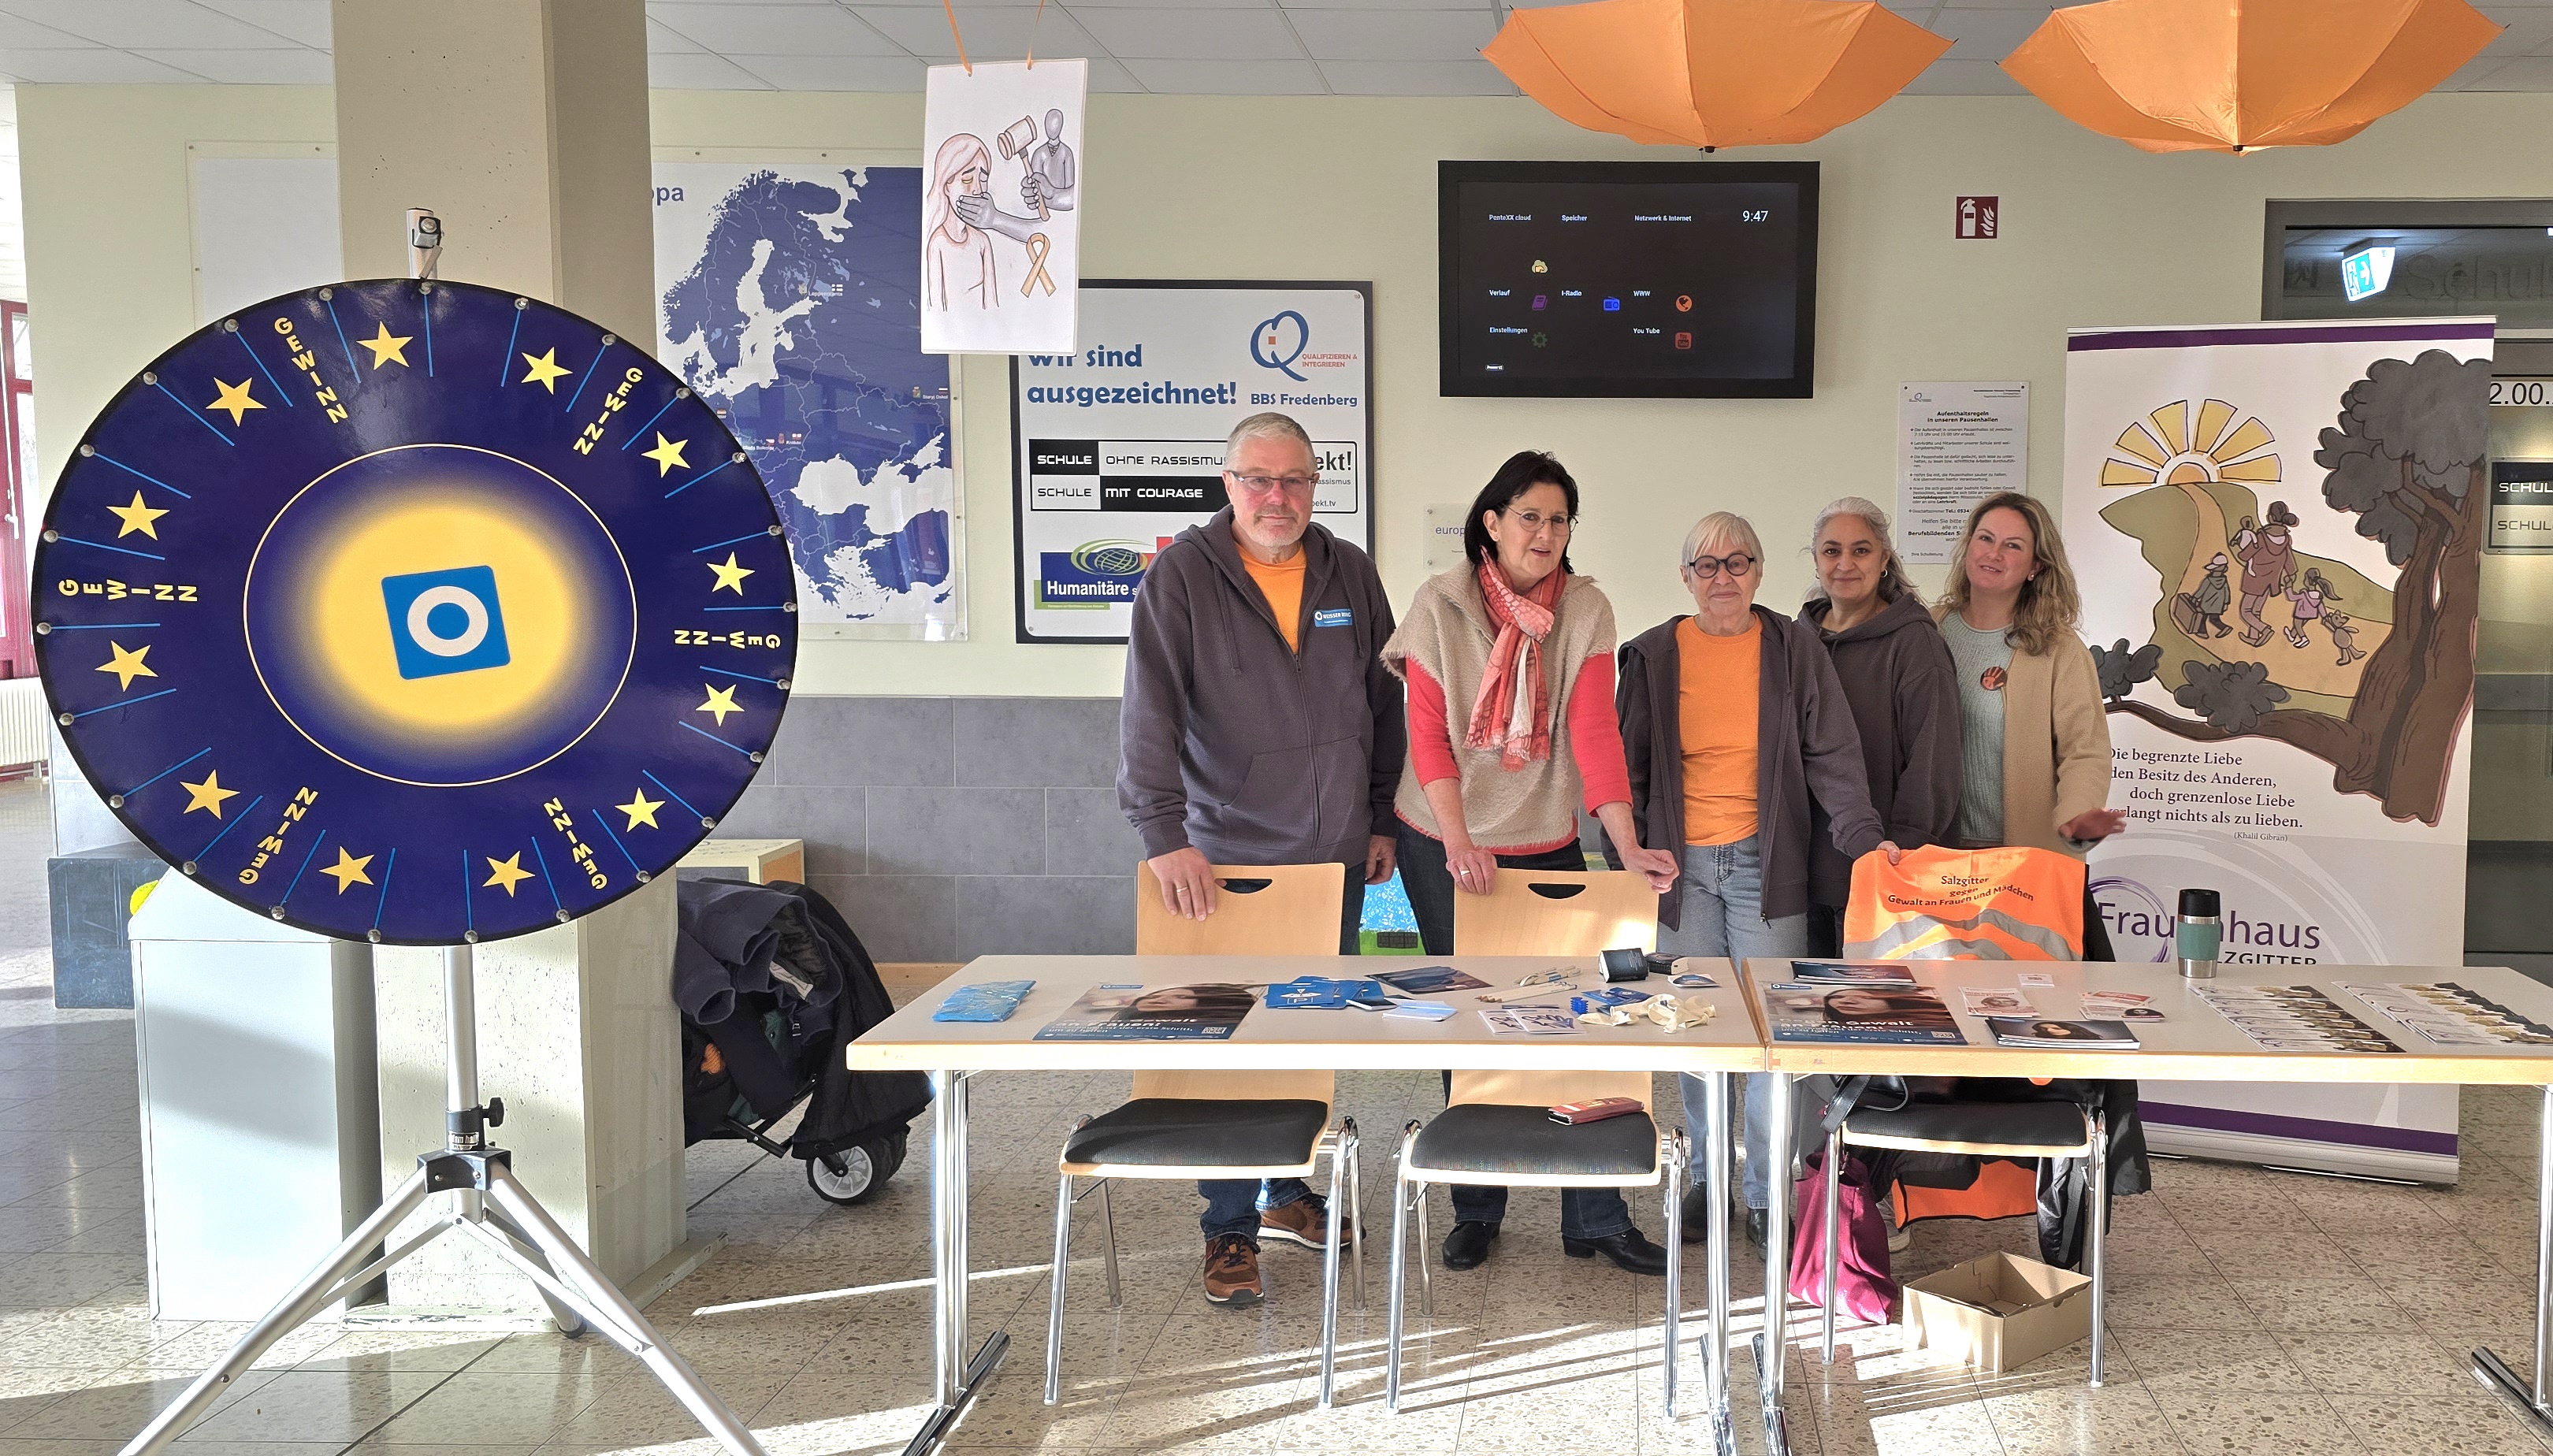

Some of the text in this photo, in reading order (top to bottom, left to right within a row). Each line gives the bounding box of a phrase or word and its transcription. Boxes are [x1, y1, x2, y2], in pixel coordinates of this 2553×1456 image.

[652, 188, 684, 206] pa
[1742, 210, 1769, 222] 9:47
[1086, 344, 1143, 367] sind
[274, 317, 348, 424] GEWINN
[1028, 381, 1236, 407] ausgezeichnet!
[1251, 393, 1358, 407] BBS Fredenberg
[573, 367, 643, 455] GEWINN
[1037, 455, 1092, 465] SCHULE
[1106, 455, 1145, 465] OHNE
[1037, 488, 1203, 498] SCHULE MIT COURAGE
[2498, 520, 2553, 531] SCHUL
[58, 579, 198, 603] GEWINN
[1046, 580, 1129, 596] Humanitäre
[674, 630, 781, 649] GEWINN
[2132, 748, 2200, 765] begrenzte
[2204, 752, 2243, 766] Liebe
[2139, 767, 2180, 782] Besitz
[2183, 770, 2207, 783] des
[2210, 772, 2276, 789] Anderen,
[2129, 786, 2295, 808] doch grenzenlose Liebe
[2110, 806, 2303, 828] langt nichts als zu lieben.
[239, 786, 318, 885] GEWINN
[543, 797, 608, 890] GEWINN
[2260, 833, 2288, 842] Gibran)
[1941, 875, 1990, 887] Salzgitter
[1888, 894, 1923, 906] Gewalt
[1939, 895, 1971, 905] Frauen
[1973, 889, 1992, 901] und
[1993, 884, 2034, 901] Mädchen
[1949, 887, 1979, 897] gegen
[2098, 901, 2321, 949] Frauhaus
